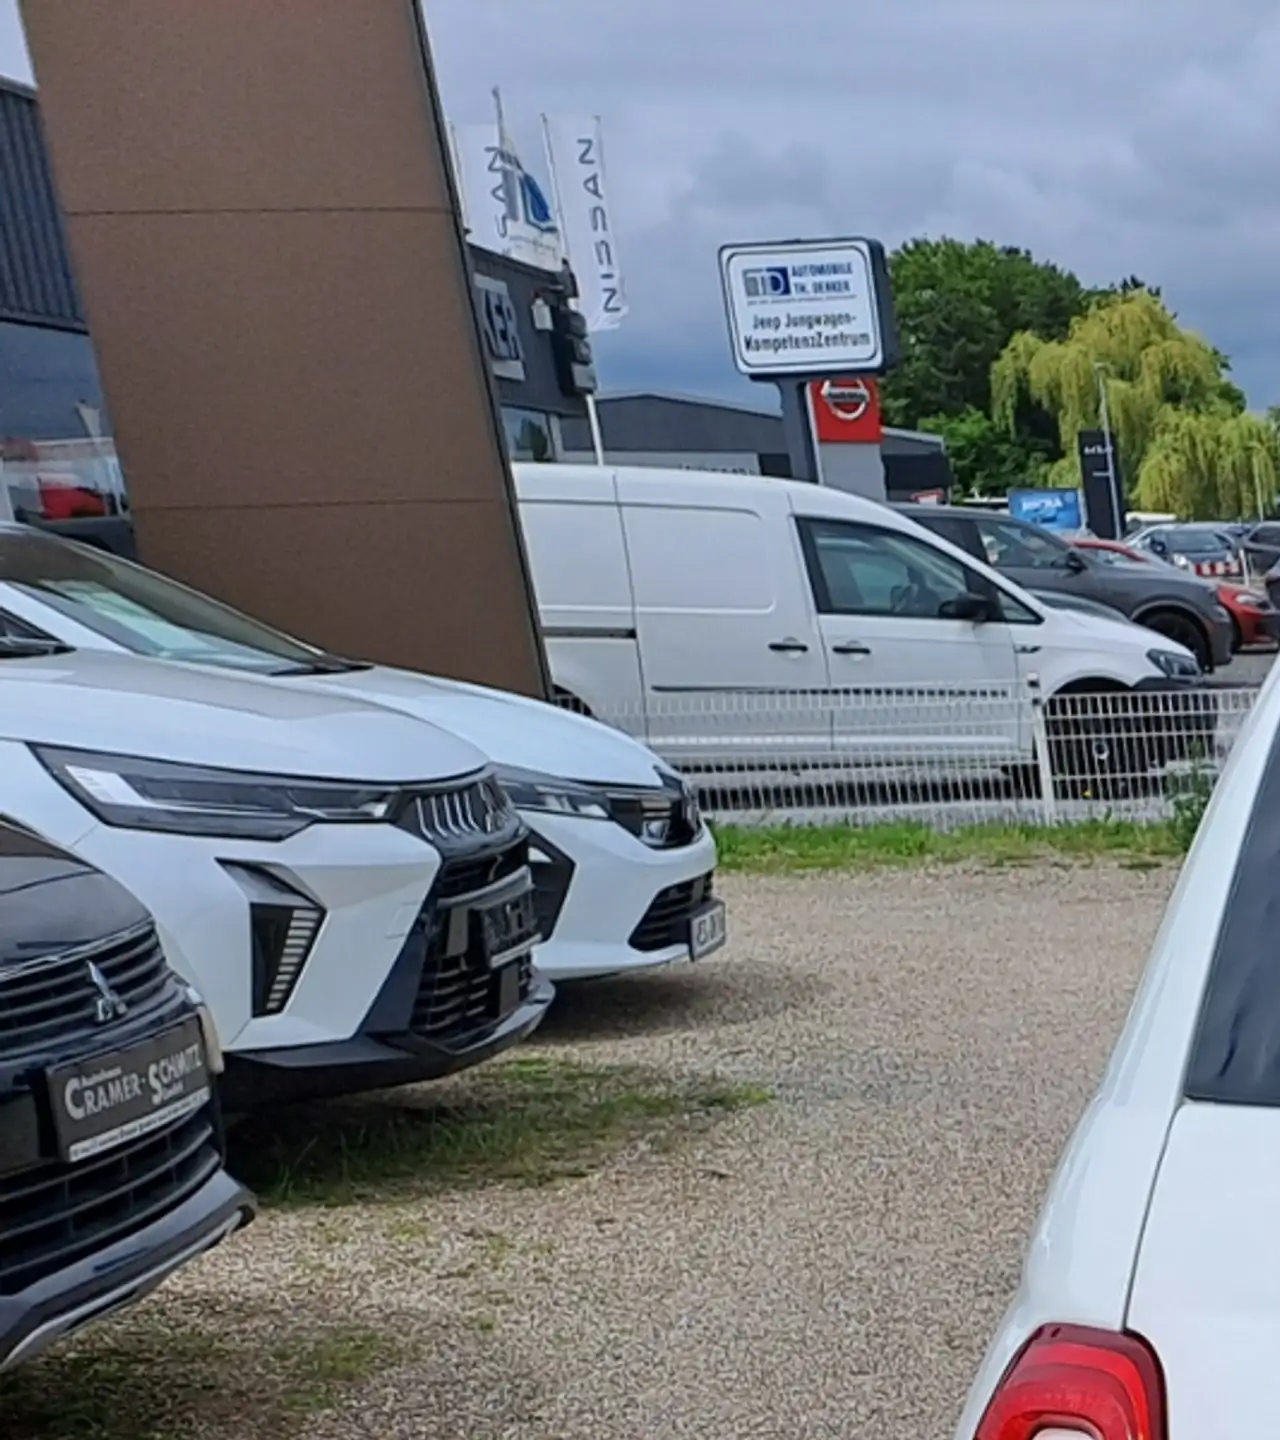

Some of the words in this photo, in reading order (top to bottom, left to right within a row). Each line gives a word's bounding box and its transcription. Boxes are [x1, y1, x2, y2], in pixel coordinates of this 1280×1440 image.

[576, 138, 622, 313] NISSAN
[792, 262, 853, 277] AUTOMOBILE
[753, 314, 781, 332] Jeep
[785, 312, 857, 330] Jungwagen-
[744, 331, 870, 354] KompetenzZentrum
